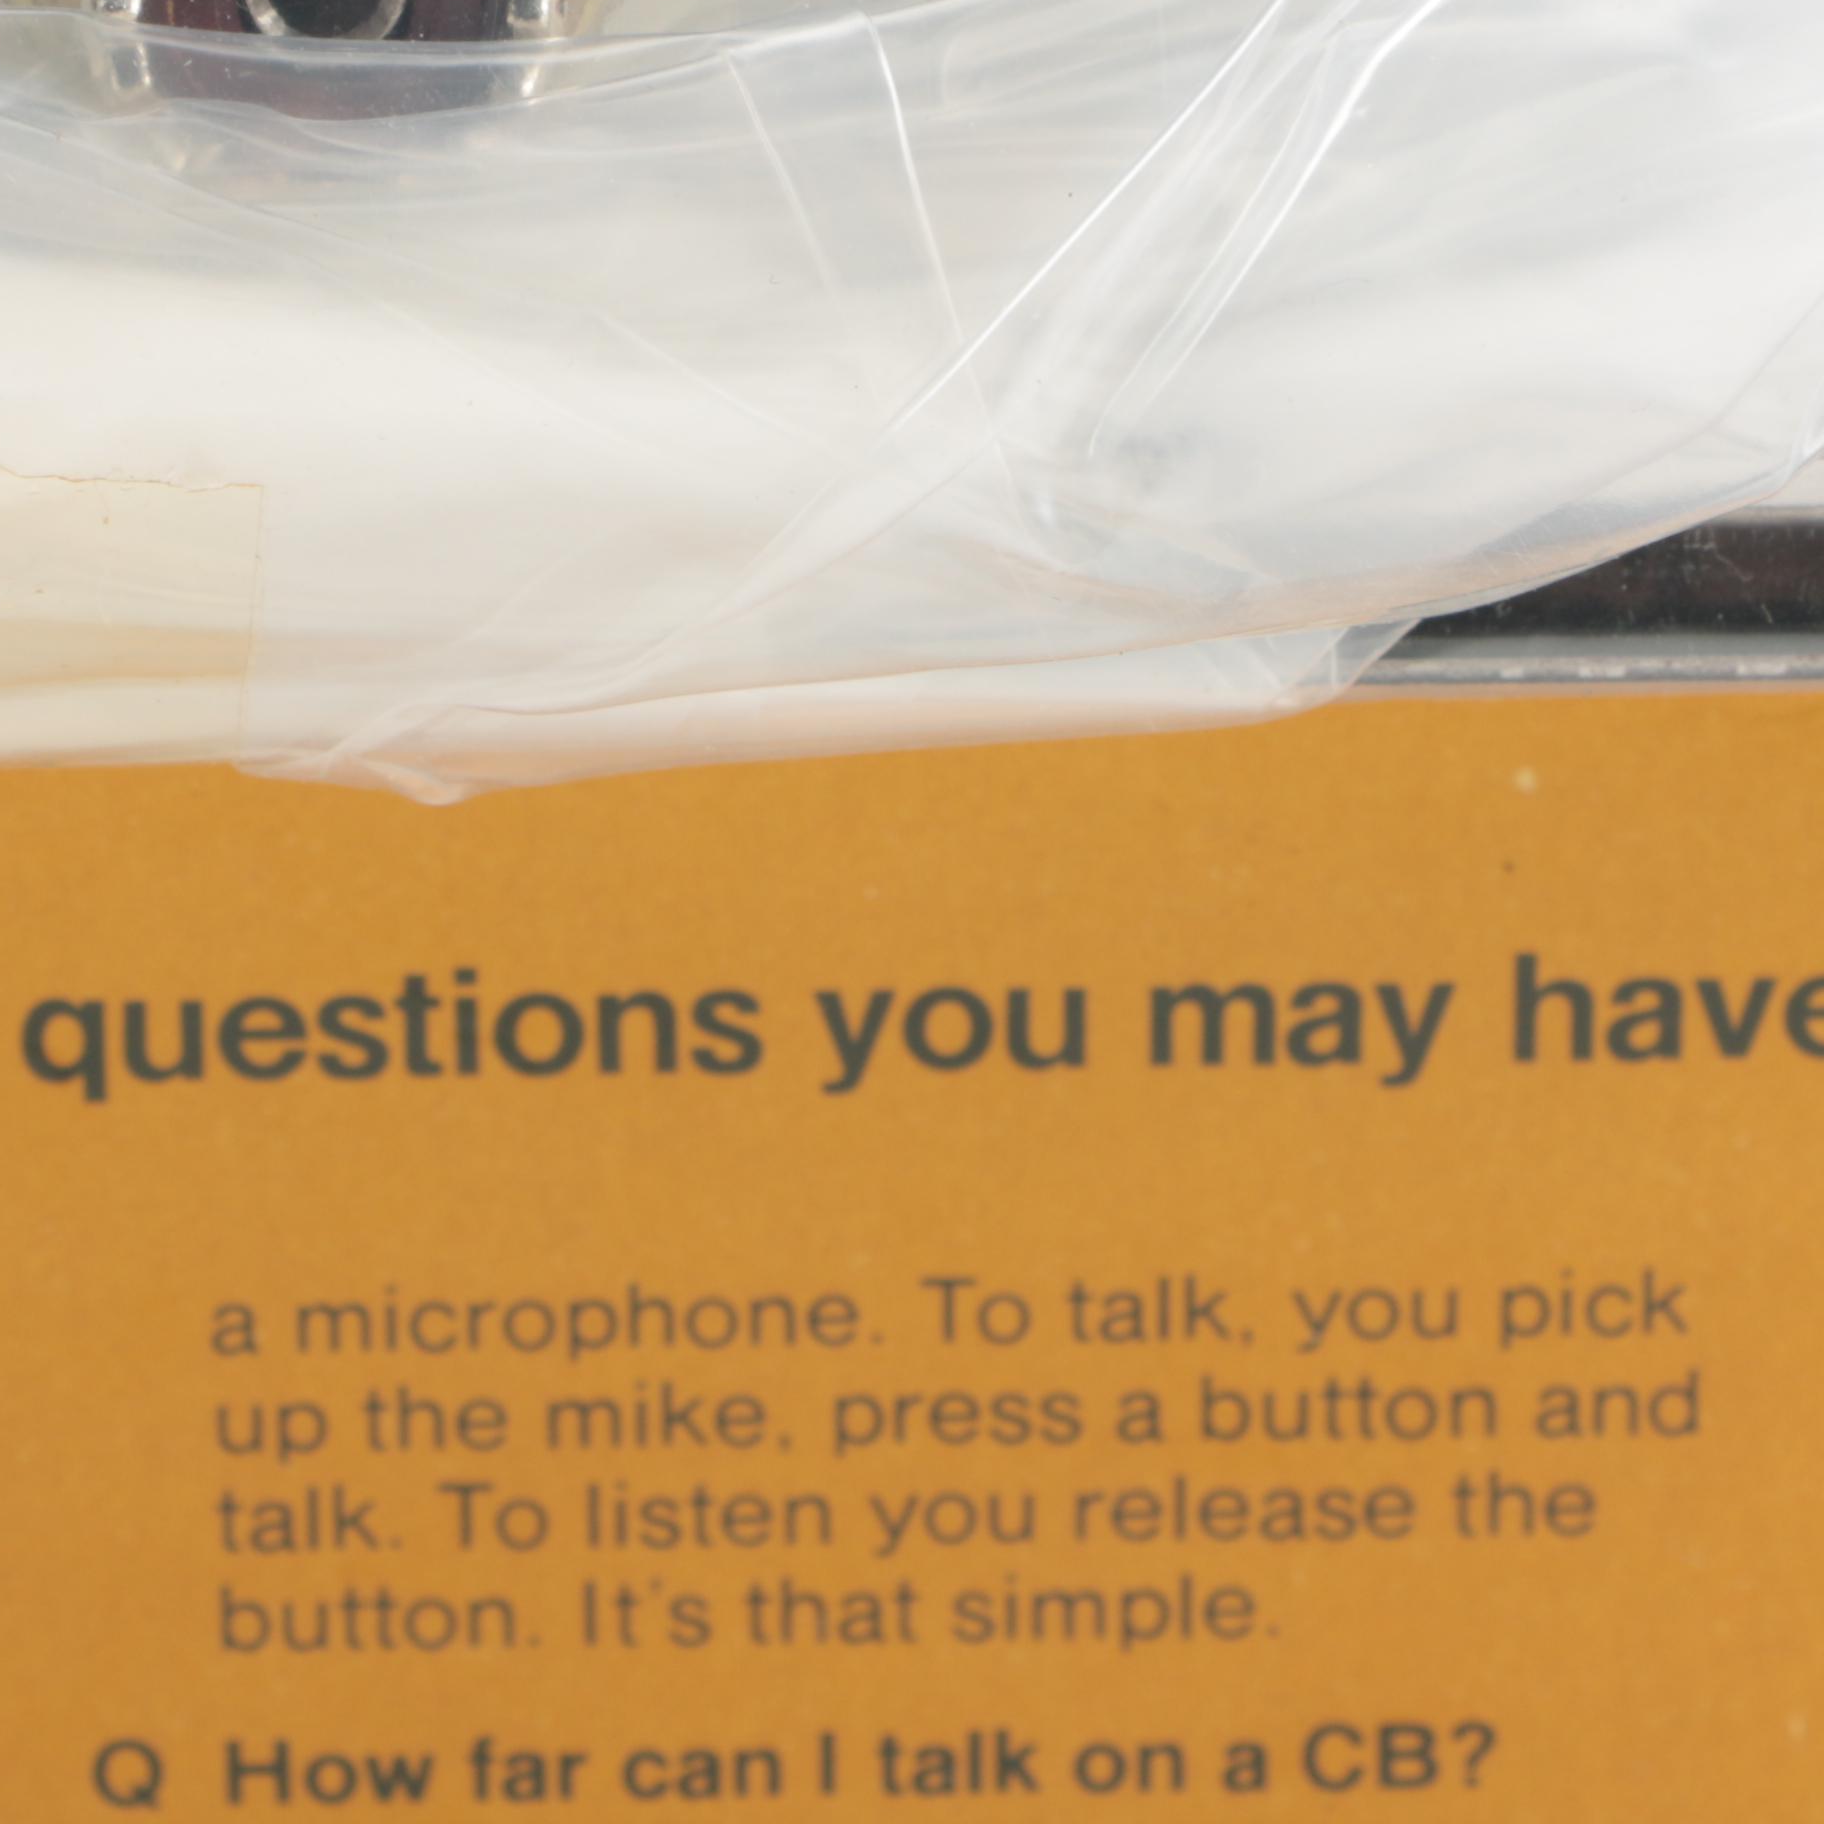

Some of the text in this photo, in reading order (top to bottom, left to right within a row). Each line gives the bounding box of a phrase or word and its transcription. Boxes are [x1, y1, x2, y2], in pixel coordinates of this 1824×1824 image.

[17, 963, 768, 1107] questions
[811, 982, 1091, 1099] you
[1145, 978, 1458, 1092] may
[209, 1301, 260, 1358] a
[294, 1281, 884, 1362] microphone.
[919, 1274, 1034, 1347] To
[1290, 1286, 1461, 1355] you
[1498, 1267, 1689, 1351] pick
[214, 1400, 330, 1465] up
[361, 1384, 510, 1454] the
[832, 1389, 1085, 1458] press
[1113, 1388, 1166, 1447] a
[1198, 1374, 1500, 1445] button
[1533, 1367, 1702, 1441] and
[215, 1469, 1599, 1560] talk. To listen you release the
[217, 1572, 1282, 1655] button. It's that simple.
[88, 1717, 1500, 1812] Q How far can I talk on a CB?
